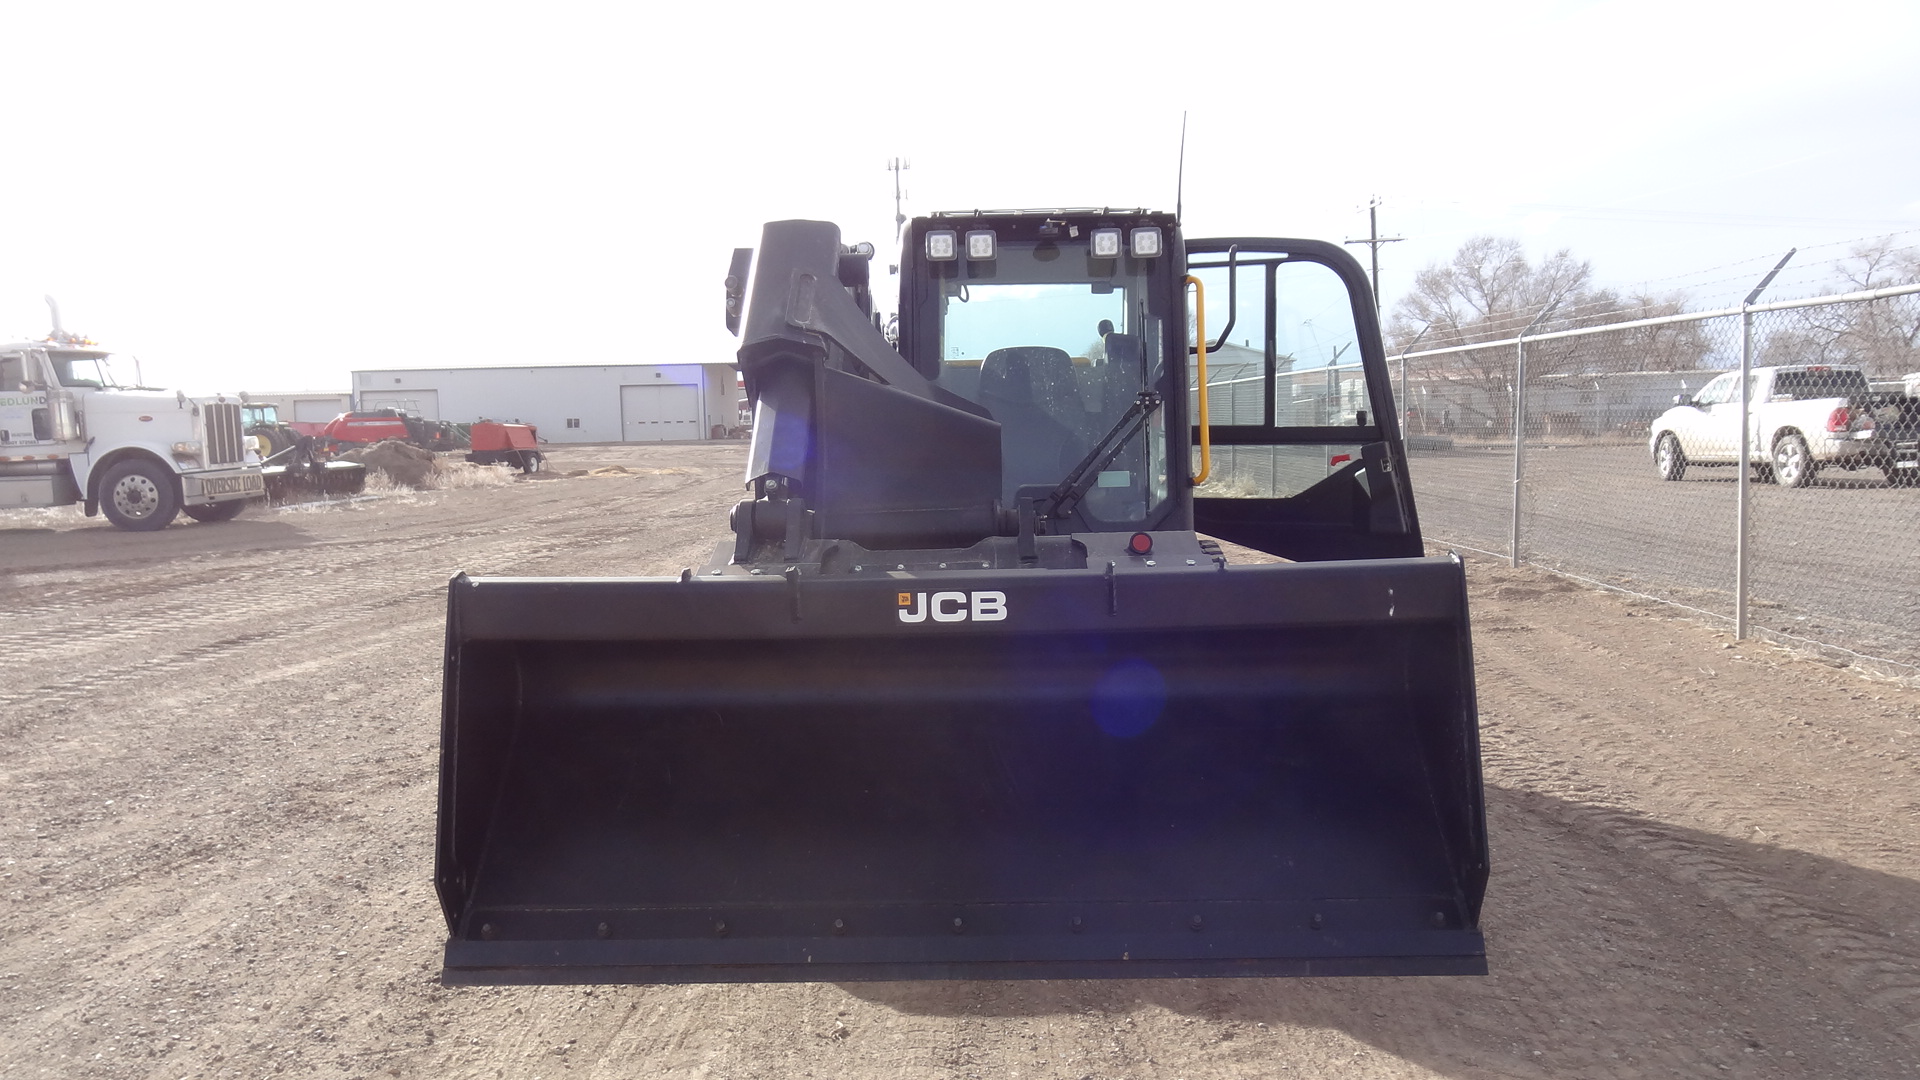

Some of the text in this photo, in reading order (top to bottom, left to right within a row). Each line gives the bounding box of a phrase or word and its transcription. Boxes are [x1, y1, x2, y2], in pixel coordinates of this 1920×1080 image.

[206, 475, 262, 495] OVERSIZE LOAD
[898, 591, 1008, 623] JCB
